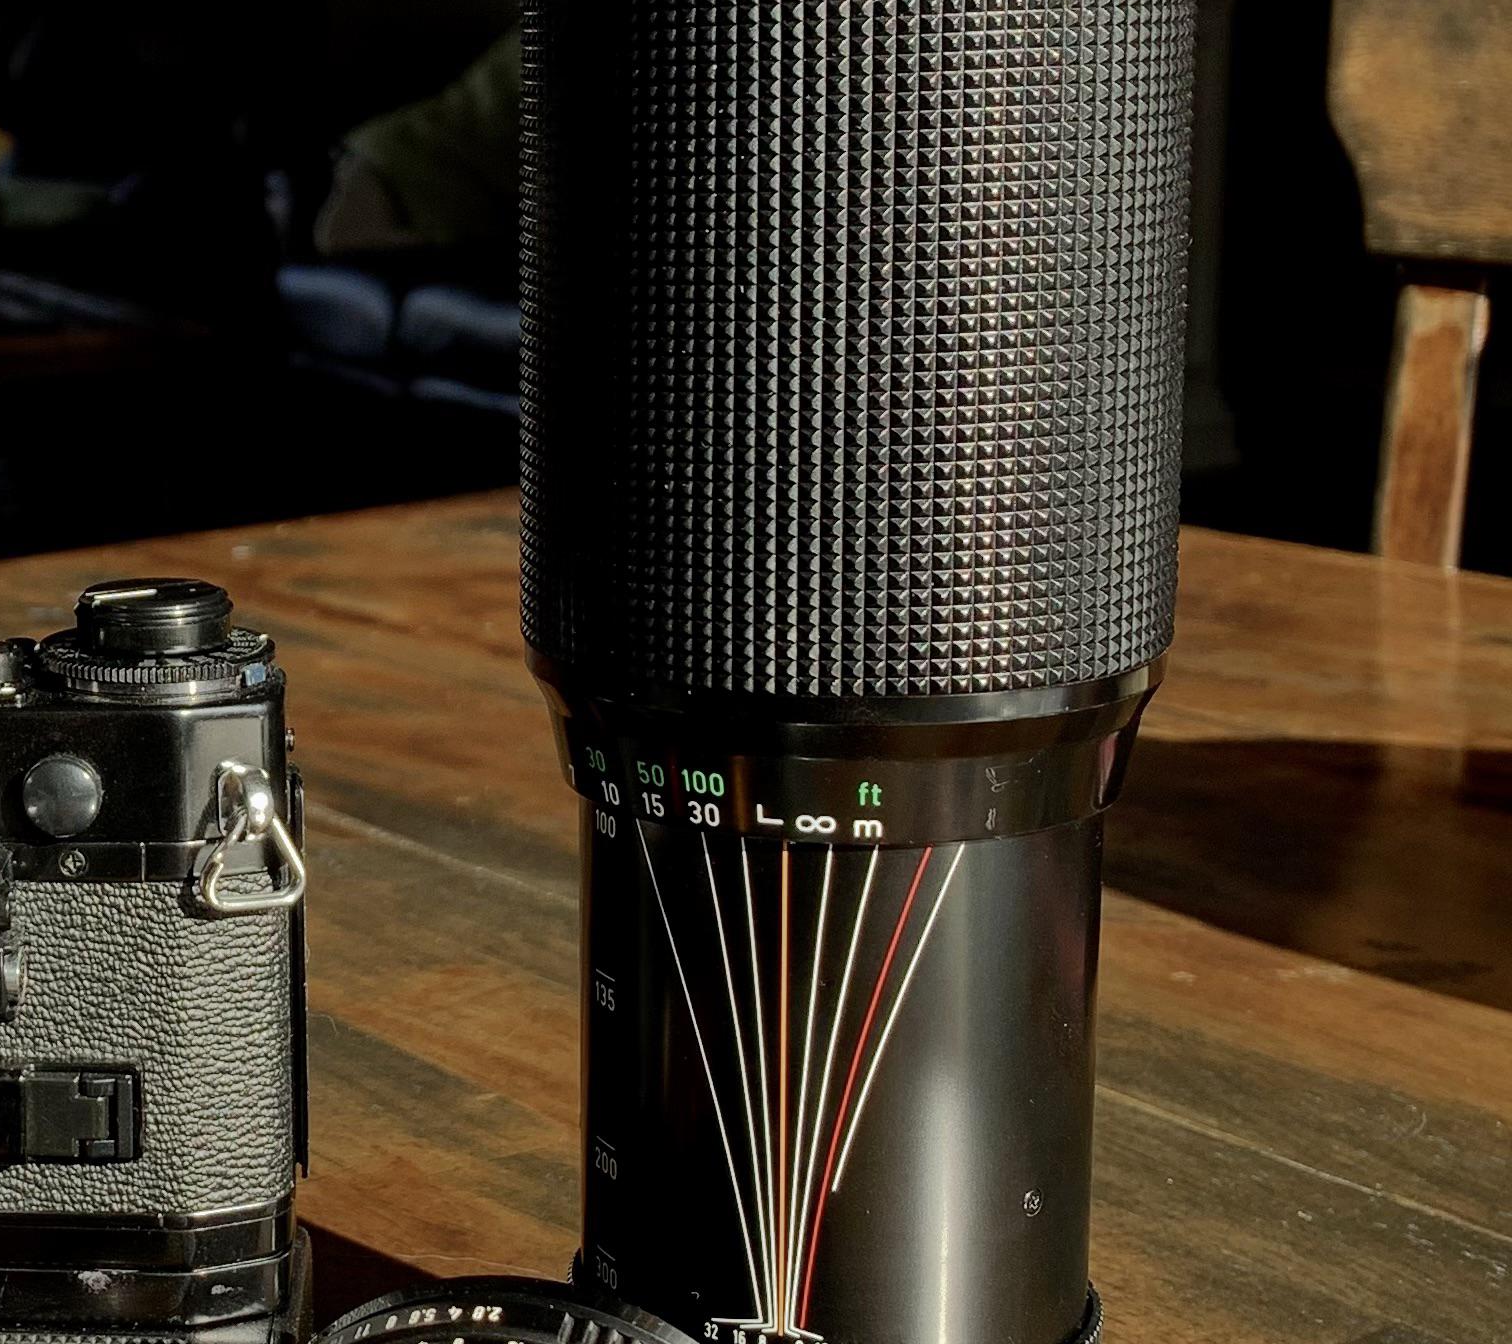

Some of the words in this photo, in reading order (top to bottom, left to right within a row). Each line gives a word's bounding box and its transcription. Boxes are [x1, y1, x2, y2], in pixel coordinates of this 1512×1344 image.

[585, 746, 606, 773] 30
[637, 760, 664, 787] 50
[680, 768, 725, 797] 100
[858, 782, 882, 806] ft
[595, 808, 617, 839] 100
[600, 779, 620, 806] 10
[642, 792, 665, 818] 15
[687, 800, 721, 828] 30
[853, 818, 883, 839] m
[595, 980, 616, 1012] 135
[595, 1146, 618, 1181] 200
[703, 1321, 719, 1341] 32
